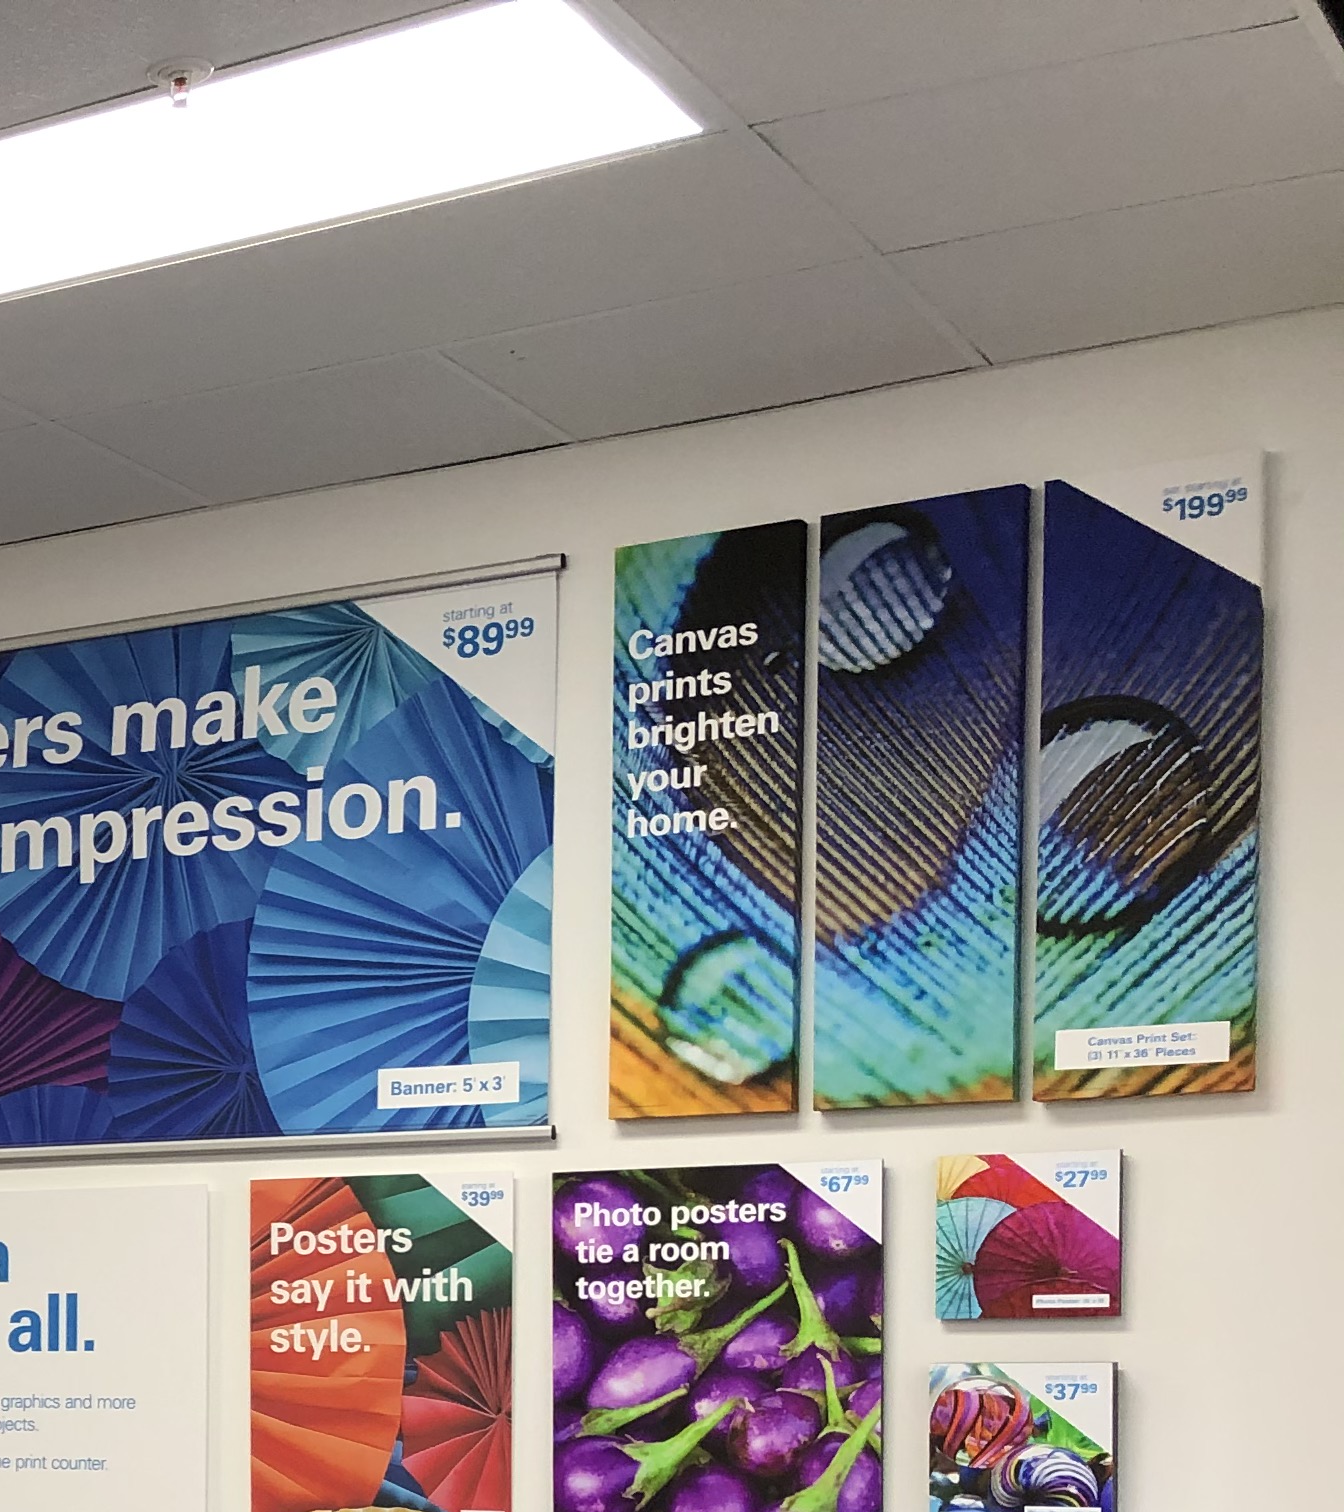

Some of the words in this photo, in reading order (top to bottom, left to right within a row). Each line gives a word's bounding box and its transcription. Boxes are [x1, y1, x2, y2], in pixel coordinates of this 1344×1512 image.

[443, 603, 495, 623] starting
[499, 601, 514, 615] at
[627, 619, 759, 661] Canvas
[627, 666, 732, 711] prints
[111, 664, 338, 754] make
[626, 708, 780, 754] brighten
[626, 761, 708, 801] your
[626, 801, 740, 839] home.
[1088, 1036, 1133, 1047] Canvas
[1136, 1033, 1167, 1044] Print
[1155, 1046, 1196, 1057] Pieces
[391, 1080, 457, 1096] Banner:
[479, 1080, 489, 1092] x
[574, 1201, 661, 1228] Photo
[670, 1199, 787, 1231] posters
[270, 1221, 413, 1255] Posters
[575, 1237, 613, 1264] tie
[622, 1243, 640, 1264] a
[649, 1240, 730, 1262] room
[270, 1277, 334, 1311] say
[346, 1269, 372, 1303] it
[383, 1267, 473, 1303] with
[575, 1272, 710, 1305] together.
[6, 1293, 96, 1353] all.
[270, 1319, 371, 1361] style.
[1, 1394, 61, 1412] graphics
[65, 1394, 92, 1409] and
[97, 1396, 136, 1409] more
[15, 1453, 47, 1472] print
[51, 1456, 109, 1471] counter.
